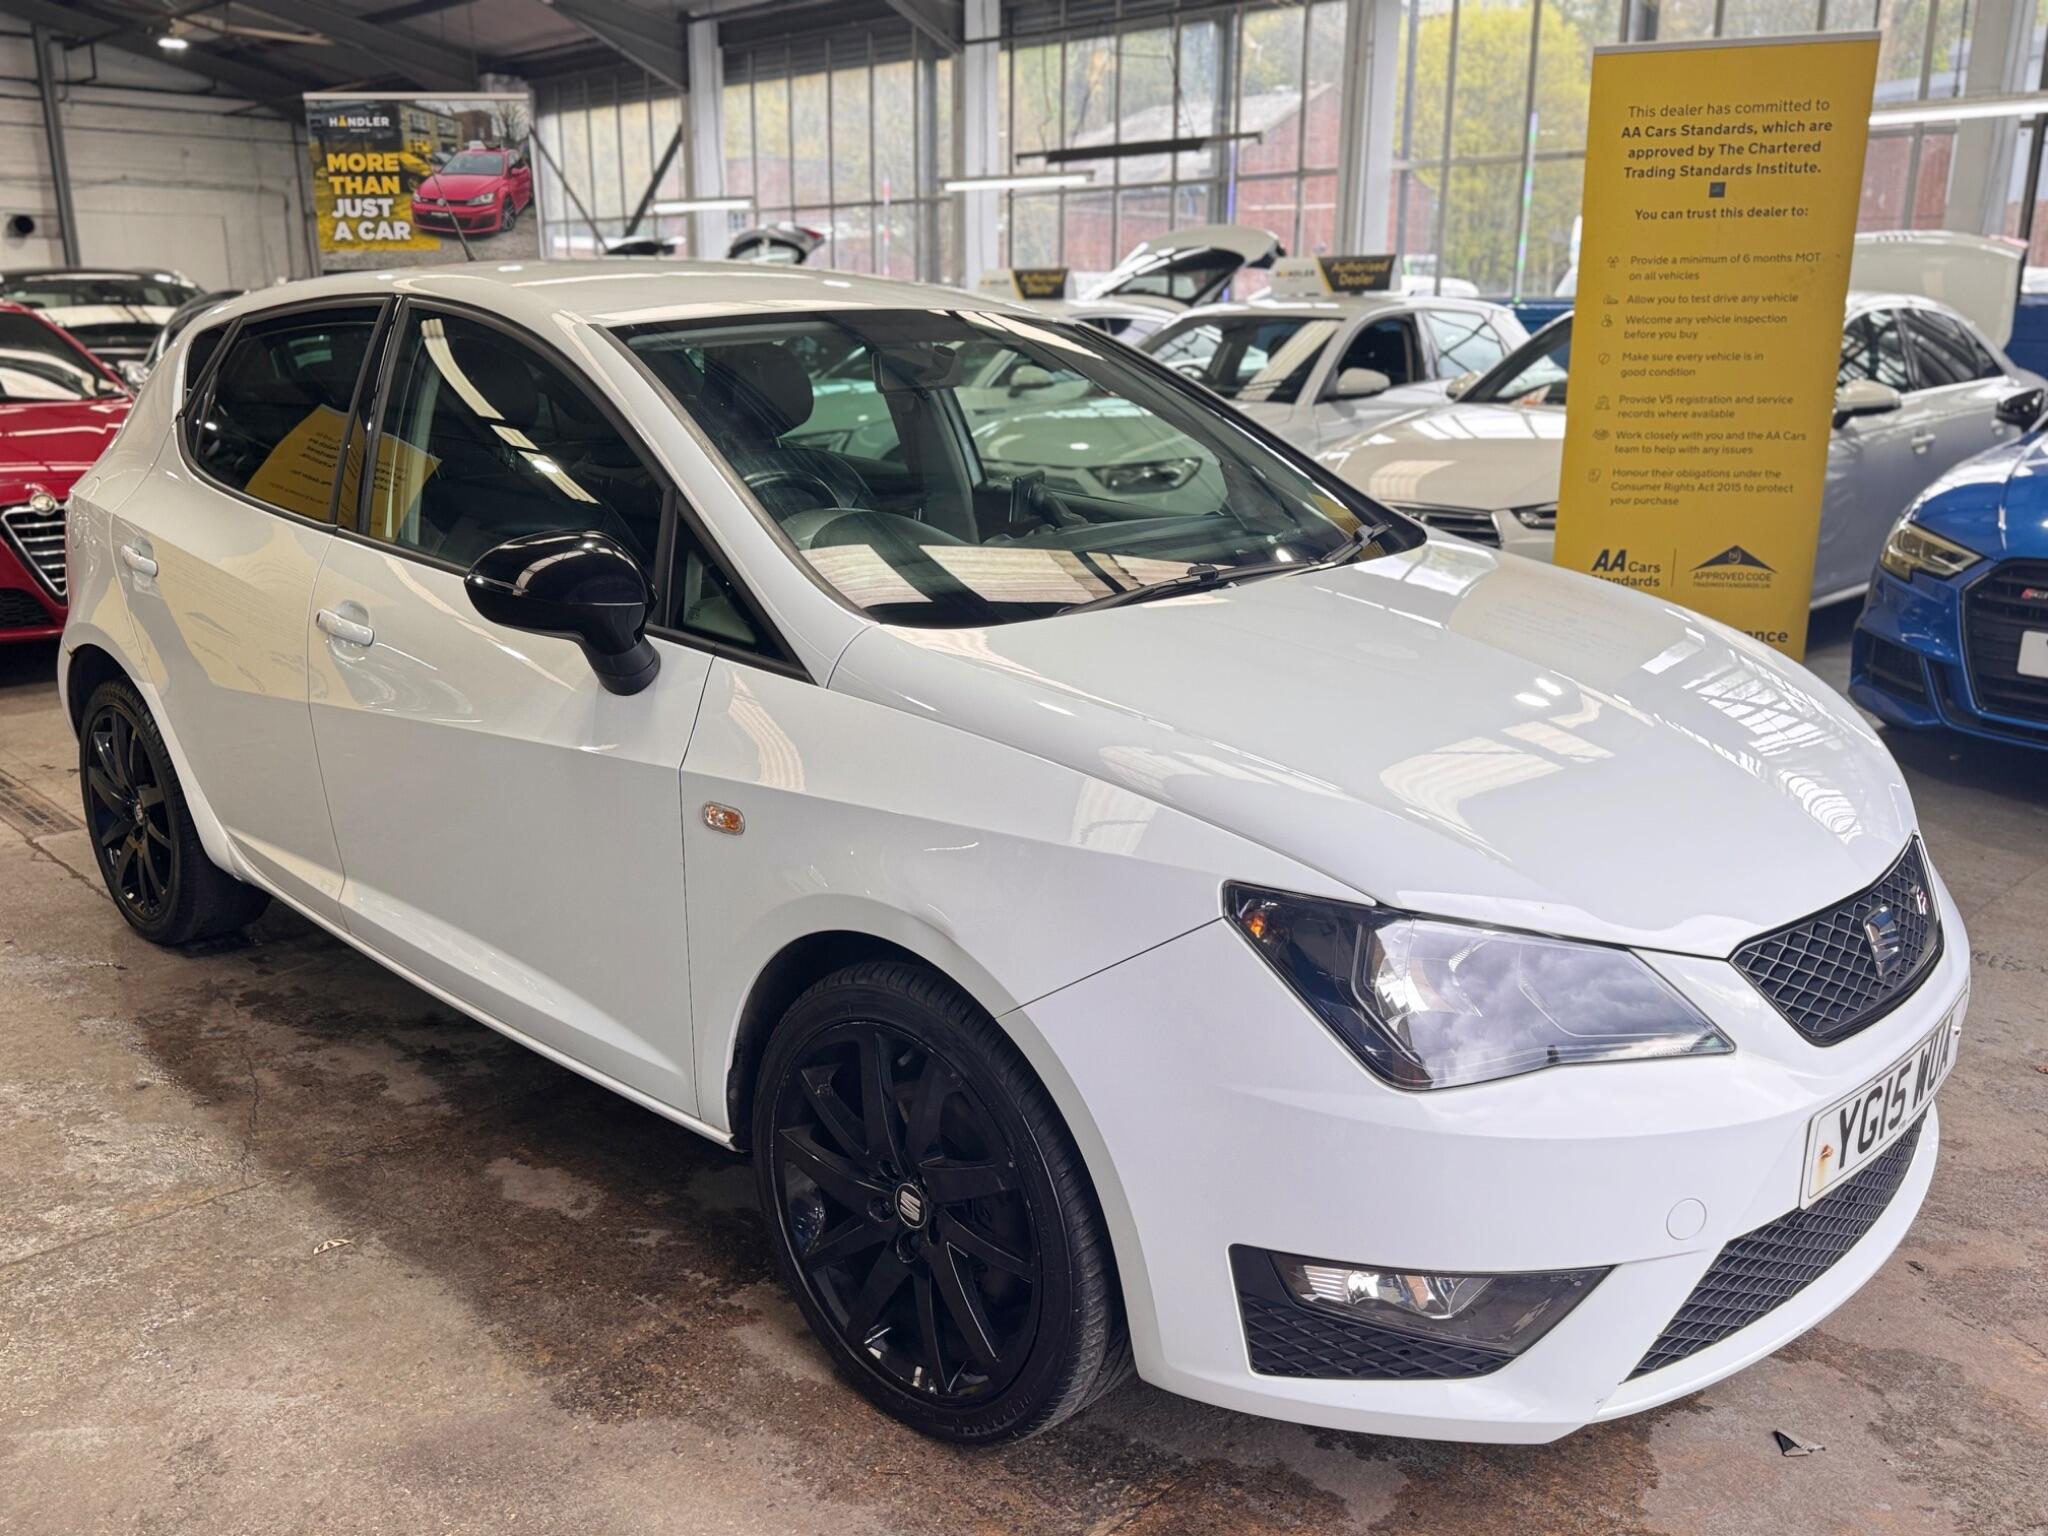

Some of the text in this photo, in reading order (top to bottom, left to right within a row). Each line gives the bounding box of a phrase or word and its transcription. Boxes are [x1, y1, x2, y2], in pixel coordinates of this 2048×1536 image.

[1628, 100, 1830, 118] This dealer has committed to
[1621, 121, 1832, 138] AA Cars Standards, which are
[1628, 141, 1821, 159] approved by The Chartered
[327, 153, 399, 172] MORE
[1624, 162, 1821, 179] Trading Standards Institute.
[328, 176, 400, 195] THAN
[333, 198, 393, 218] JUST
[1635, 205, 1809, 220] You can trust this dealer to:
[334, 221, 411, 241] A CAR
[1630, 255, 1668, 265] Provide
[1680, 255, 1728, 265] minimum
[1730, 254, 1741, 263] of
[1743, 254, 1750, 263] 6
[1753, 253, 1792, 263] months
[1795, 252, 1820, 262] MOT
[1629, 270, 1700, 281] on all vehicles
[1626, 292, 1799, 304] Allow you to test drive any vehicle
[1626, 314, 1787, 325] Welcome any vehicle inspection
[1624, 330, 1698, 340] before you buy
[1622, 352, 1648, 361] Make
[1676, 354, 1703, 363] every
[1706, 352, 1742, 361] vehicle
[1744, 352, 1752, 361] is
[1754, 352, 1764, 361] in
[1620, 367, 1696, 378] good condition
[1619, 395, 1793, 405] Provide V5 registration and service
[1618, 410, 1735, 419] records where available
[1616, 431, 1806, 442] Work closely with you and the AA Cars
[1615, 445, 1753, 455] team to help with any issues
[1613, 469, 1781, 479] Honour their obligations under the
[1611, 482, 1793, 494] Consumer Rights Act 2015 to protect
[1610, 497, 1679, 507] your purchase
[1591, 549, 1661, 573] AA Cars
[1592, 575, 1660, 587] ndards
[1694, 572, 1771, 581] APPROVED CODE
[1839, 1013, 1954, 1169] YG15 WUA
